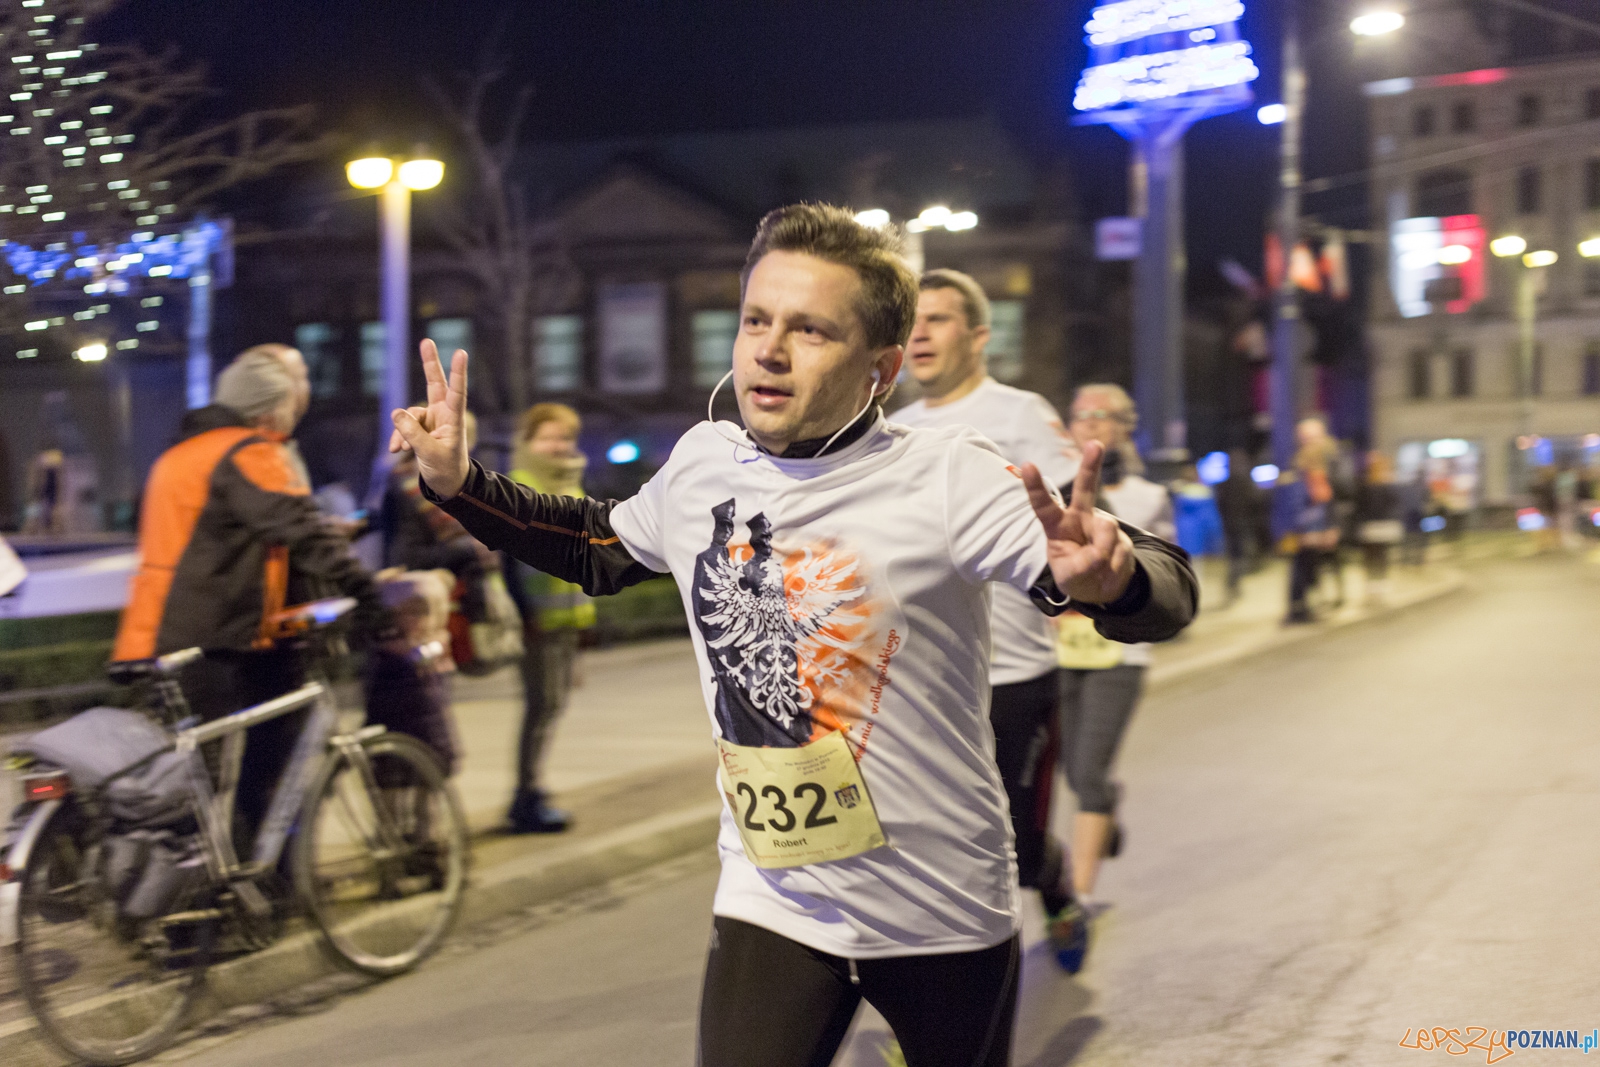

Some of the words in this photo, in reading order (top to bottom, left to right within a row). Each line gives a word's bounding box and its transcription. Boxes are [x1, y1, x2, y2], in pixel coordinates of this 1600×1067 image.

[870, 629, 901, 715] wielkopolskiego
[736, 781, 839, 833] 232
[773, 837, 808, 849] Robert
